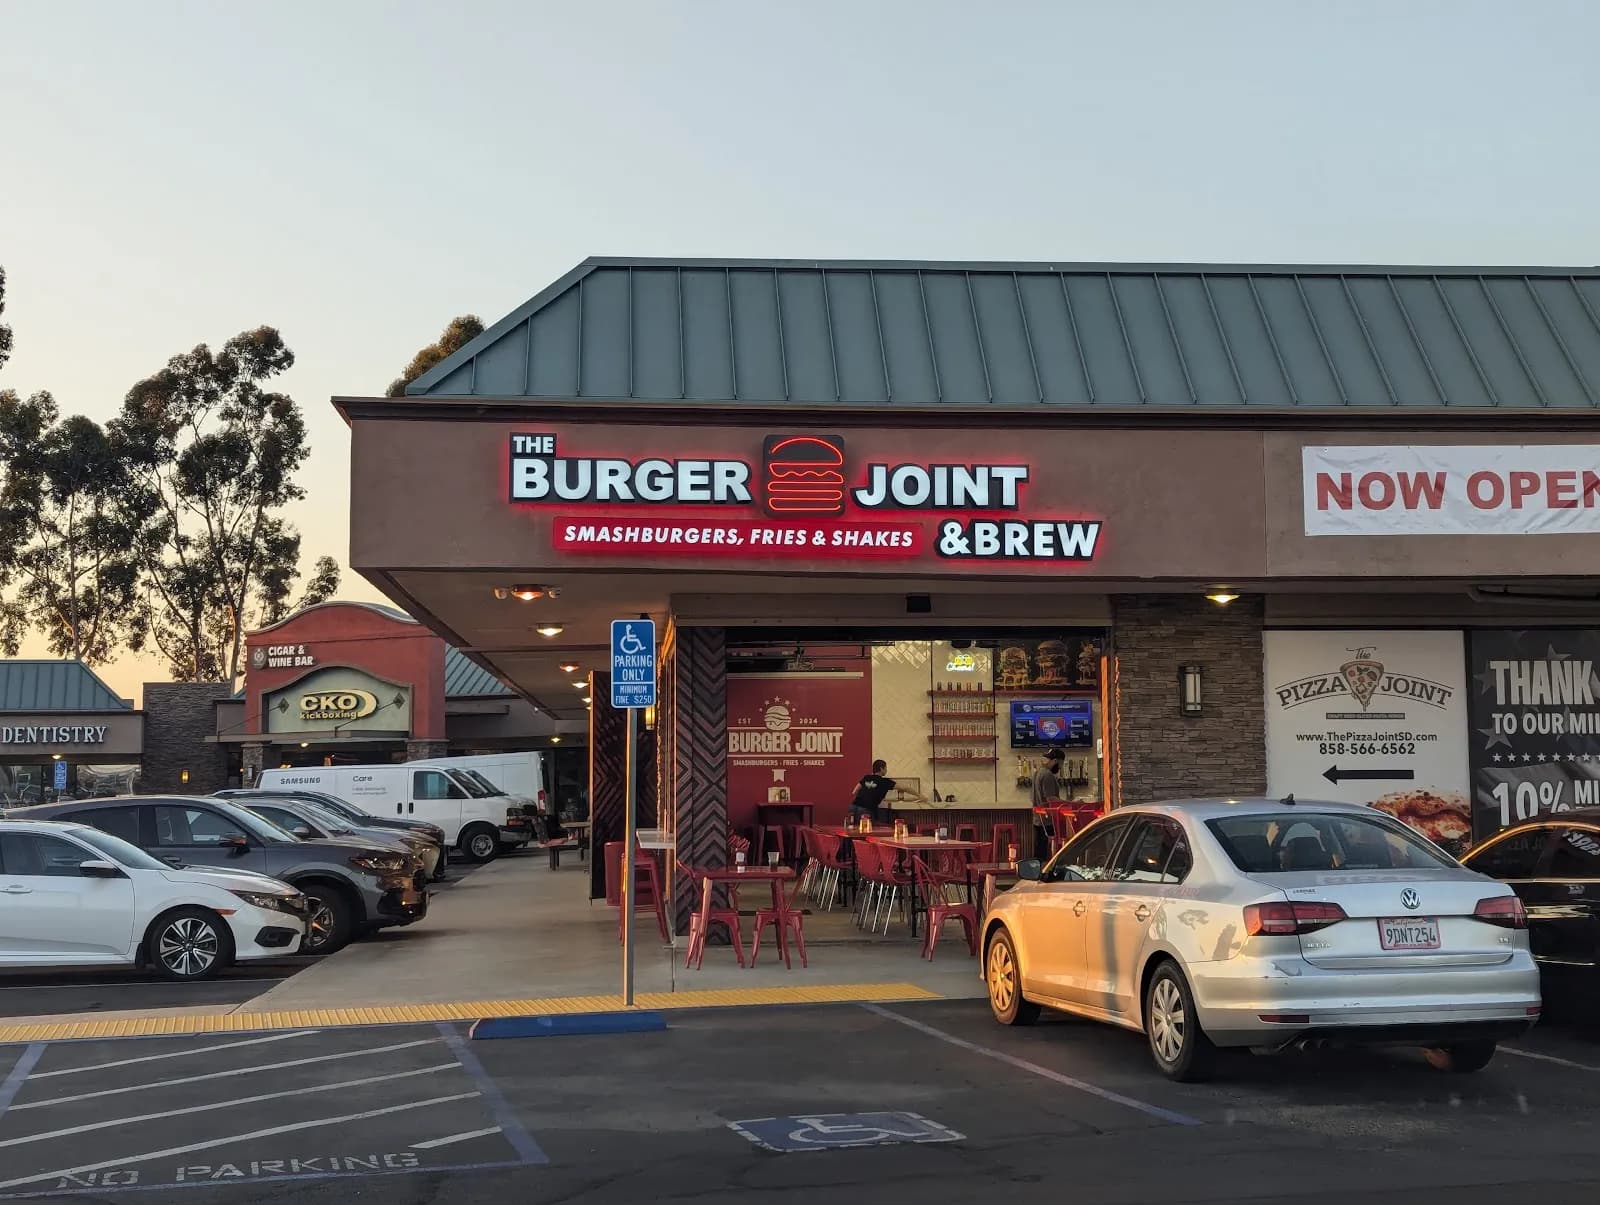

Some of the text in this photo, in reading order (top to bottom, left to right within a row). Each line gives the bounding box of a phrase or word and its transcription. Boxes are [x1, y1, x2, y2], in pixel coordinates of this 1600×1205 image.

[513, 436, 554, 454] THE
[513, 458, 1028, 507] BURGER JOINT
[1316, 471, 1448, 511] NOW
[564, 525, 913, 547] SMASHBURGERS, FRIES & SHAKES
[939, 521, 1100, 557] &BREW
[268, 645, 305, 656] CIGAR &
[1346, 646, 1377, 660] The
[268, 656, 313, 668] WINE BAR
[614, 655, 653, 668] PARKING
[622, 669, 646, 681] ONLY
[1489, 660, 1595, 705] THANK
[619, 685, 648, 694] MINIMUM
[1276, 676, 1452, 707] PIZZA JOINT
[300, 695, 358, 711] CKO
[615, 695, 652, 704] FINE $250
[300, 710, 357, 720] kickboxing
[1492, 713, 1518, 734] TO
[1522, 713, 1564, 734] OUR
[2, 726, 107, 743] DENTISTRY
[728, 732, 843, 752] BURGER JOINT
[1296, 731, 1438, 742] www.ThePizzaJointSD.com
[1319, 743, 1416, 755] 858-566-6562
[280, 777, 321, 785] SAMSUNG
[1386, 927, 1437, 944] 9DNT254
[56, 1153, 419, 1188] NO PARKING
